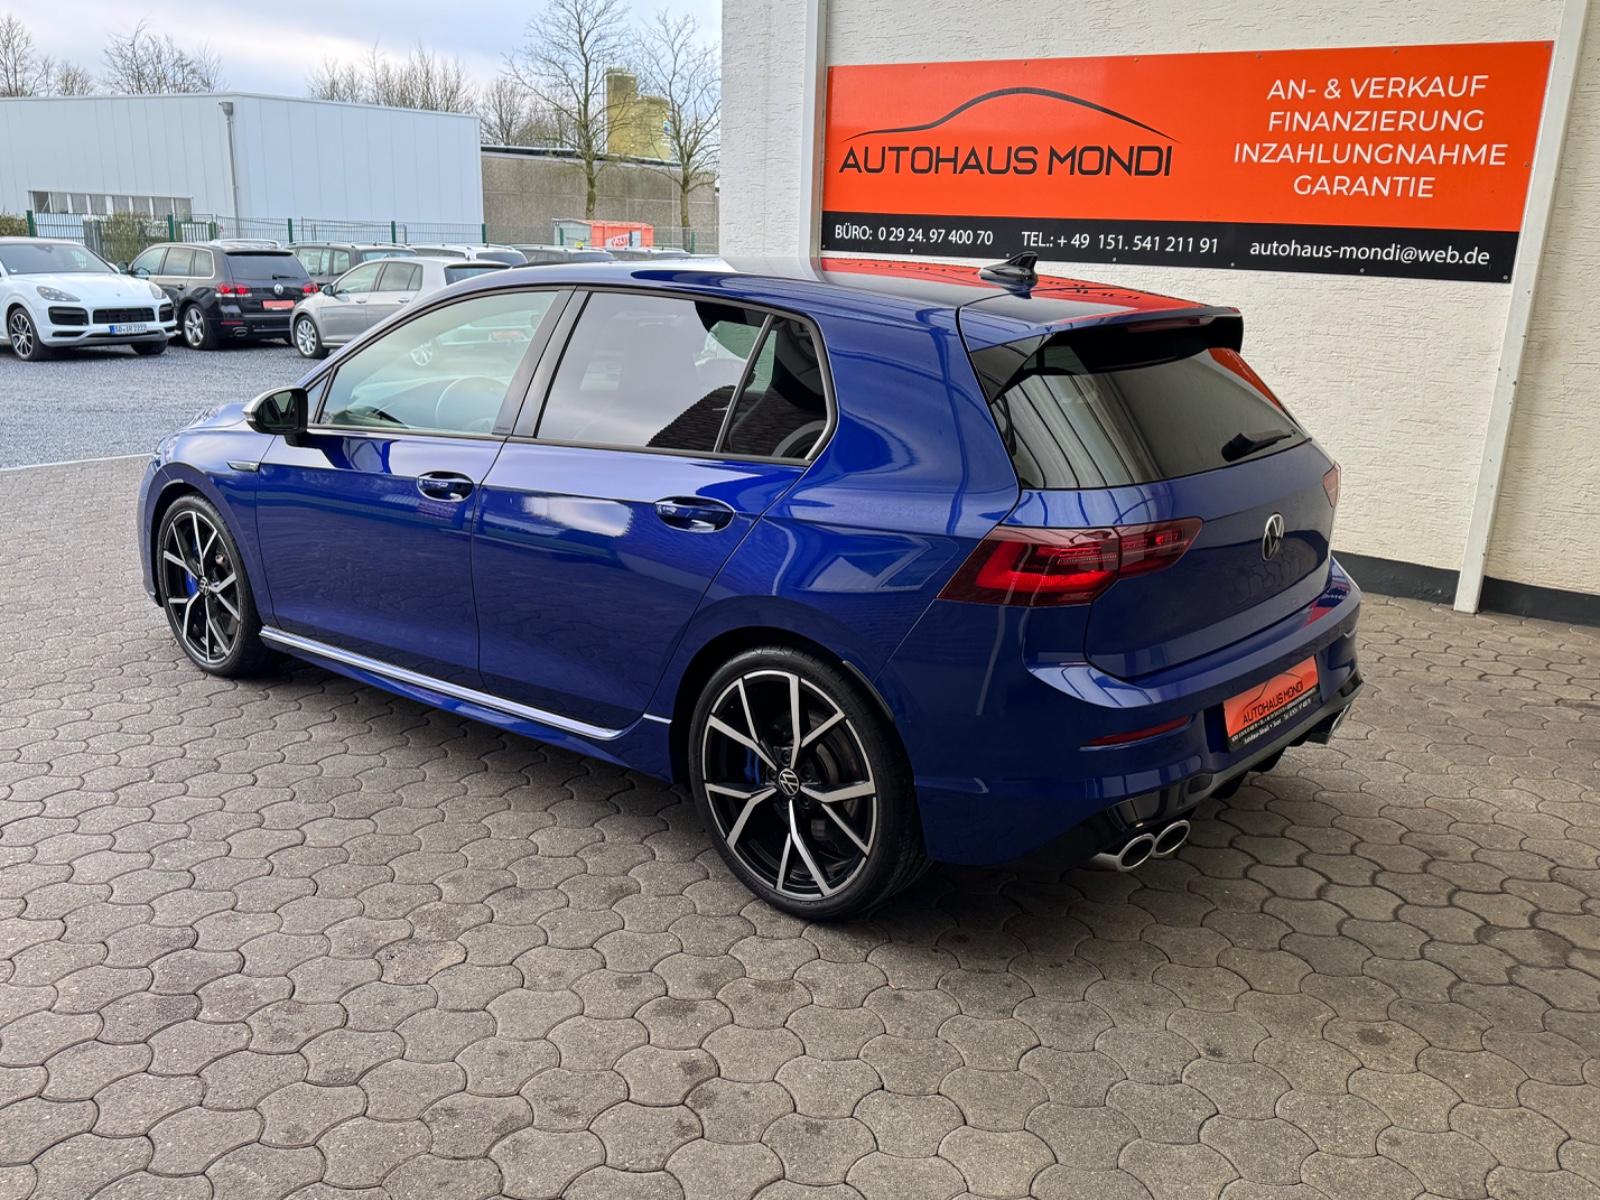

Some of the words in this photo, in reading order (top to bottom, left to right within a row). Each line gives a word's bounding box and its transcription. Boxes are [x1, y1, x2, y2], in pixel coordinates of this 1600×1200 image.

[1267, 79, 1316, 100] AN-
[1324, 78, 1341, 99] &
[1350, 75, 1489, 98] VERKAUF
[1268, 109, 1484, 132] FINANZIERUNG
[839, 146, 1039, 175] AUTOHAUS
[1047, 145, 1173, 177] MONDI
[1234, 143, 1508, 166] INZAHLUNGNAHME
[1293, 174, 1436, 198] GARANTIE
[835, 222, 873, 241] BÜRO:
[888, 227, 905, 242] 29
[907, 227, 927, 243] 24.
[929, 229, 946, 244] 97
[948, 229, 974, 245] 400
[976, 230, 994, 246] 70
[1021, 231, 1054, 248] TEL.:
[1099, 234, 1129, 251] 151.
[1132, 235, 1160, 251] 541
[1165, 236, 1194, 253] 211
[1199, 238, 1218, 254] 91
[1249, 239, 1490, 265] autohaus-mondi@web.de
[1242, 692, 1284, 725] AUTOHAUS
